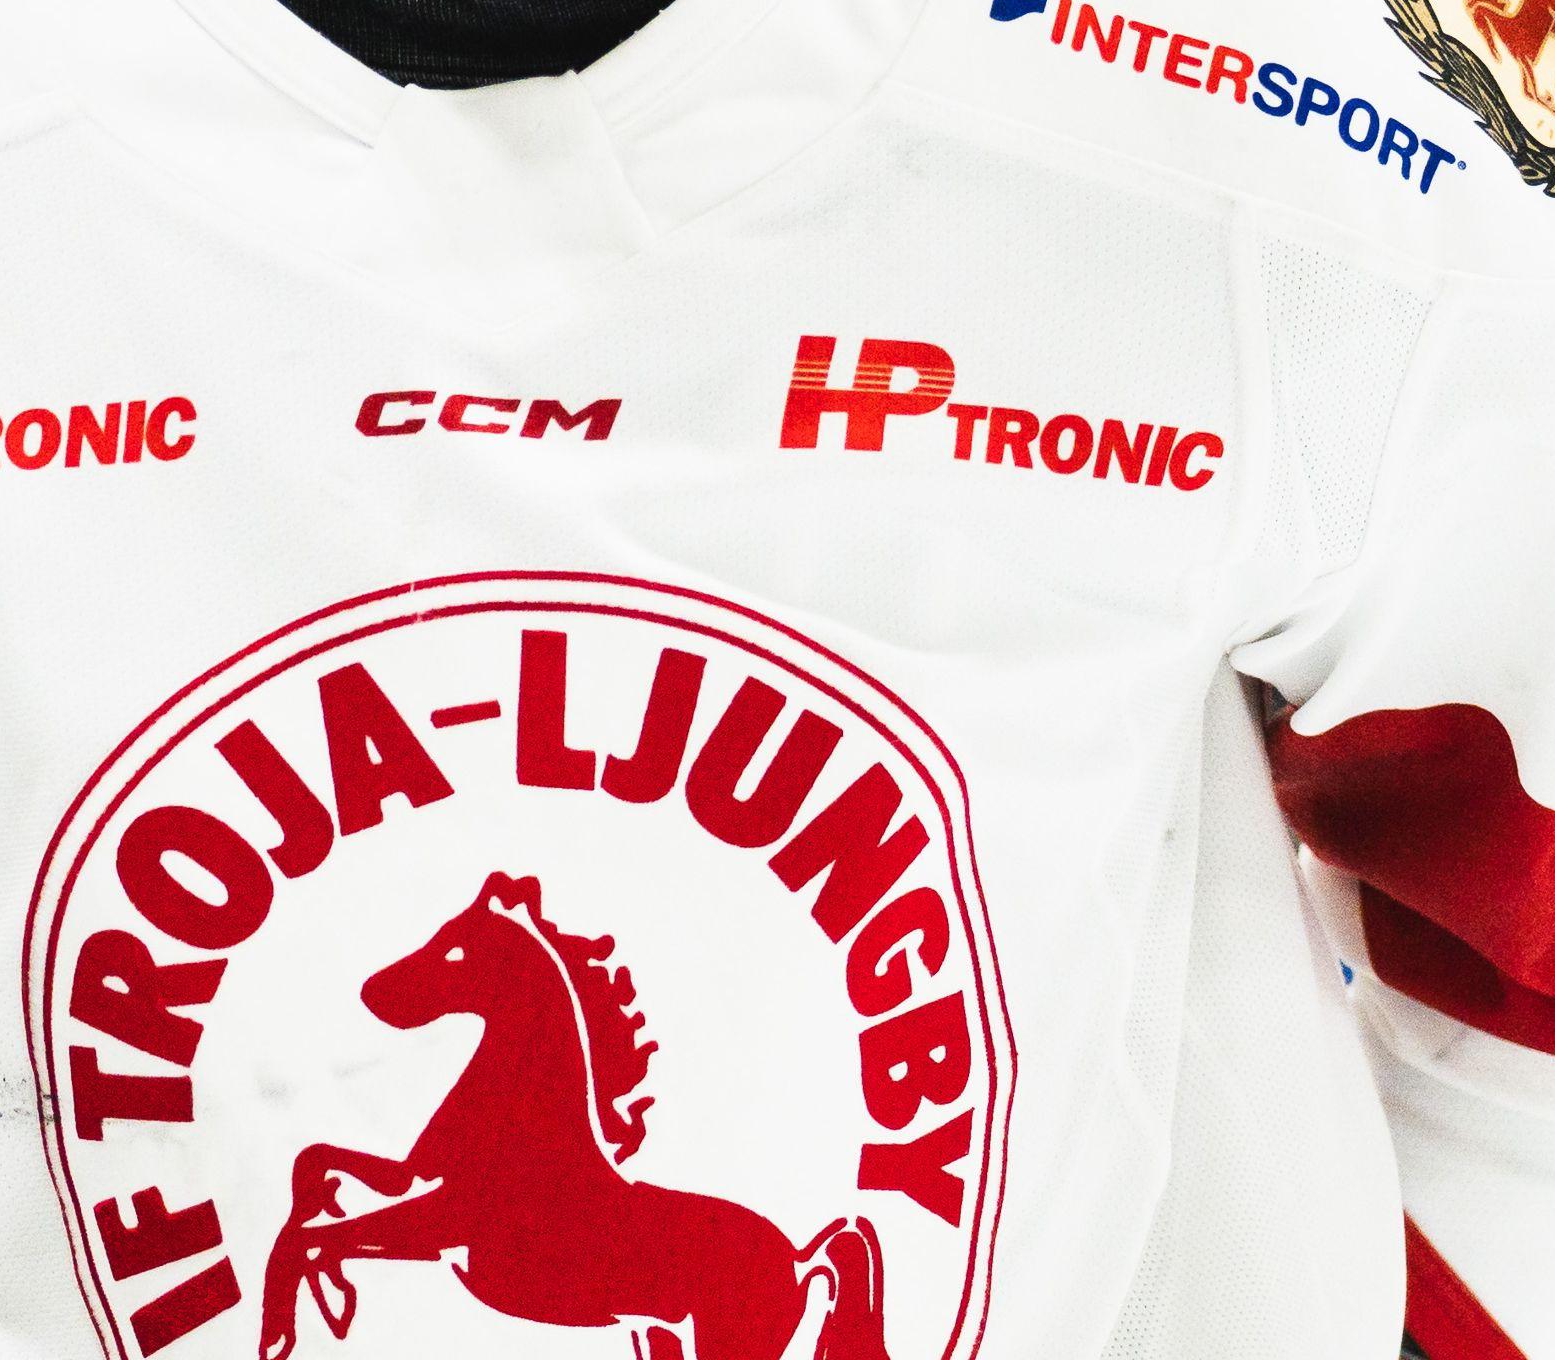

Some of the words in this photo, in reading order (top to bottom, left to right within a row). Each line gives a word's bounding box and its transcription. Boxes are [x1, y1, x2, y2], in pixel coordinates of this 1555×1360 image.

[354, 390, 623, 441] CCM
[946, 403, 1225, 492] TRONIC
[68, 629, 975, 1228] TROJA-LJUNGBY
[92, 1185, 243, 1358] IF
